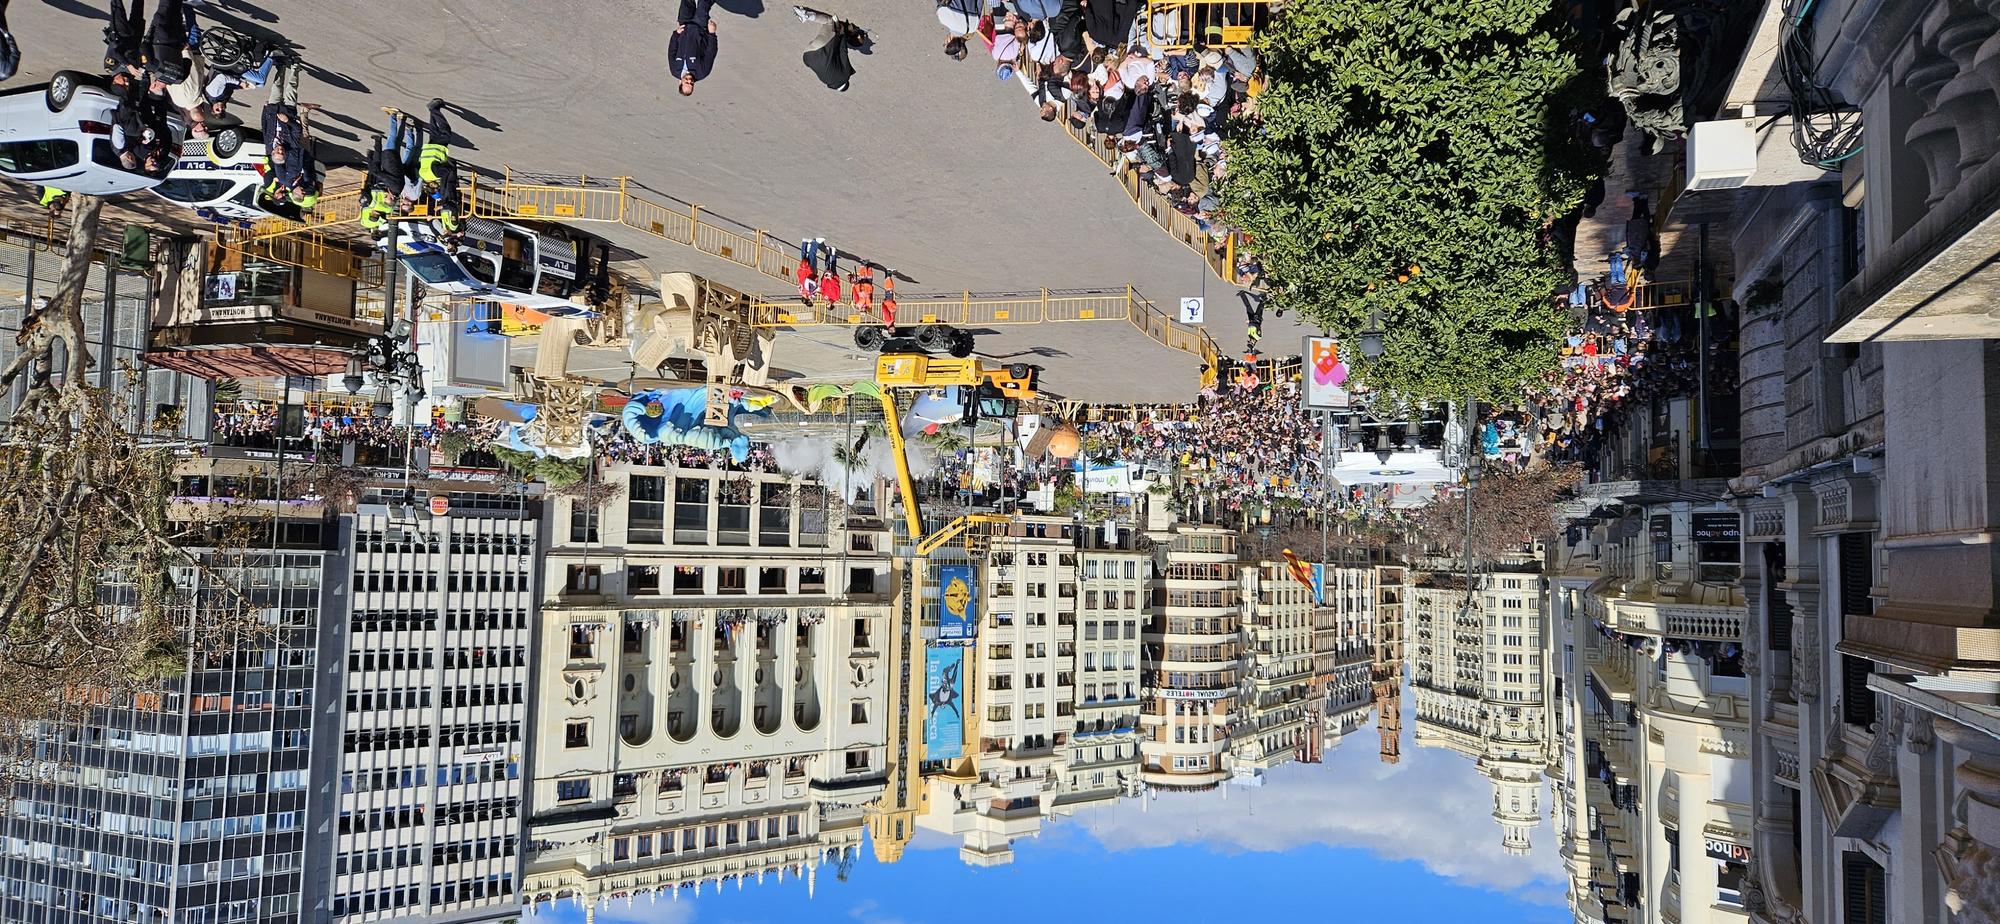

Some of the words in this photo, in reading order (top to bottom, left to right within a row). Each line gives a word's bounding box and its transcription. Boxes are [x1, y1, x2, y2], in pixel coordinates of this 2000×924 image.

[554, 260, 569, 270] PLV
[211, 308, 246, 317] MONTAÑANA
[315, 313, 351, 326] MONTAÑANA
[930, 661, 940, 672] la
